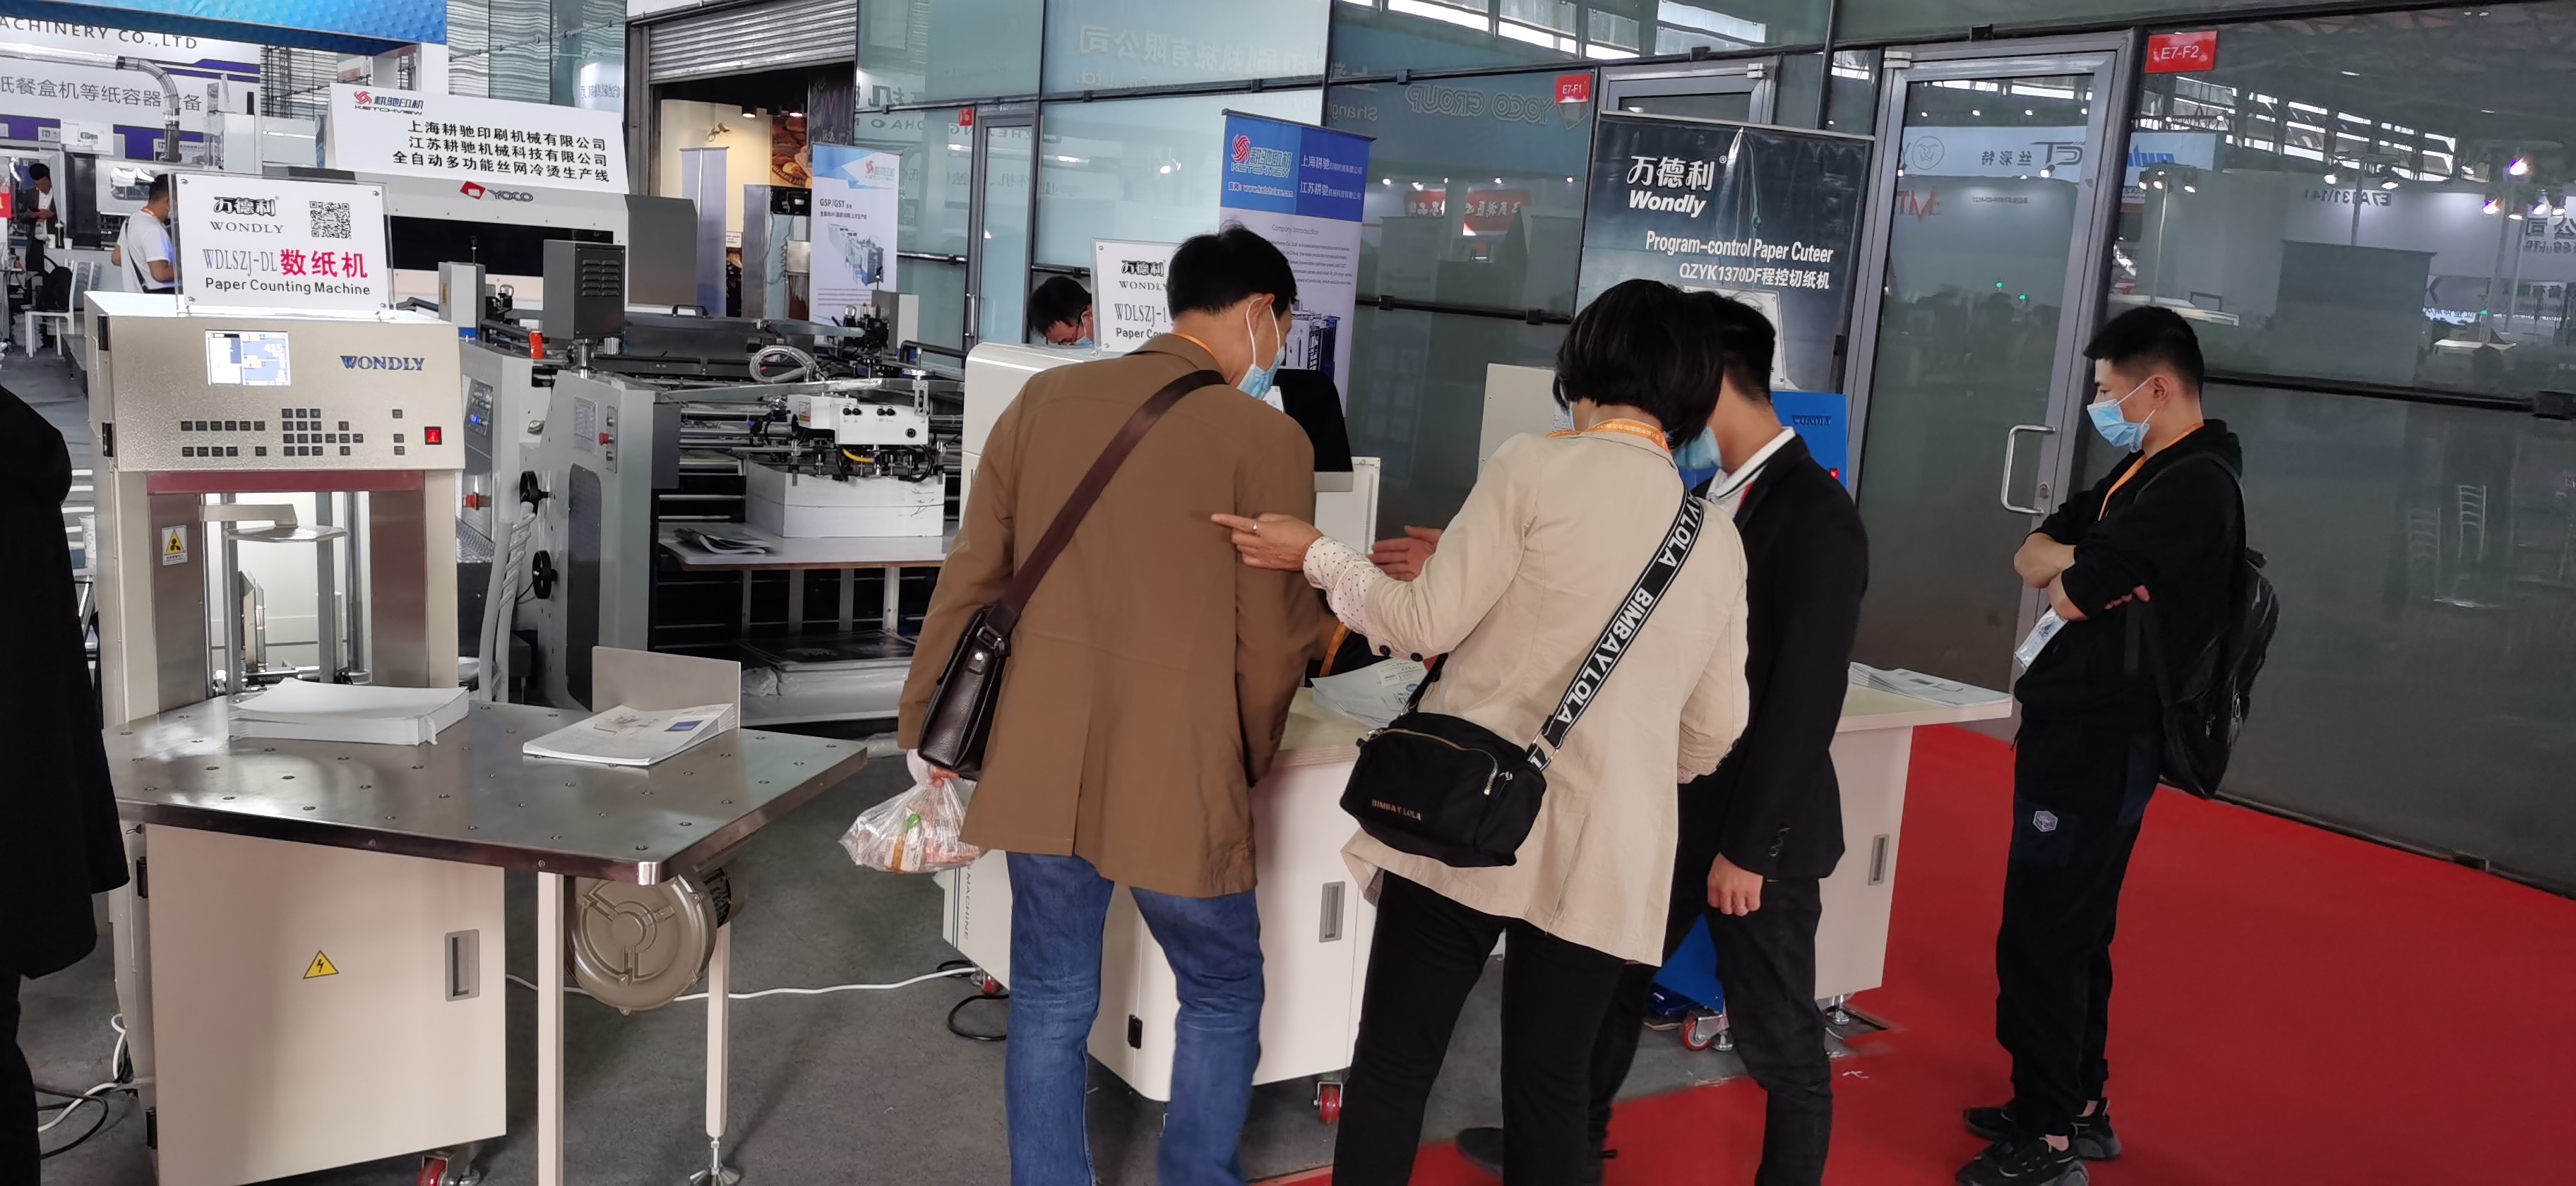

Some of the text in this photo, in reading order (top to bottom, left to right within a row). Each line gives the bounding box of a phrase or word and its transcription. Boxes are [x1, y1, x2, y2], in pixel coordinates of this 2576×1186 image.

[2161, 46, 2199, 59] E7-F2
[1562, 83, 1582, 94] E7-F1
[407, 120, 606, 151] 上海耕驰印刷机械有限公司
[409, 136, 607, 167] 江苏耕驰机械科技有限公司
[393, 150, 609, 182] 全自动多功能丝网冷烫生产线
[1626, 155, 1715, 191] 万德利
[213, 196, 276, 217] 万德利
[1629, 189, 1707, 217] Wondly
[210, 221, 284, 234] WONDLY
[1645, 230, 1834, 263] Program-control Paper Cuteer
[203, 248, 368, 278] WDLSZJ-DL 数纸机
[205, 277, 370, 295] Paper Counting Machine
[1116, 328, 1145, 340] Paper
[340, 356, 425, 371] WONDLY
